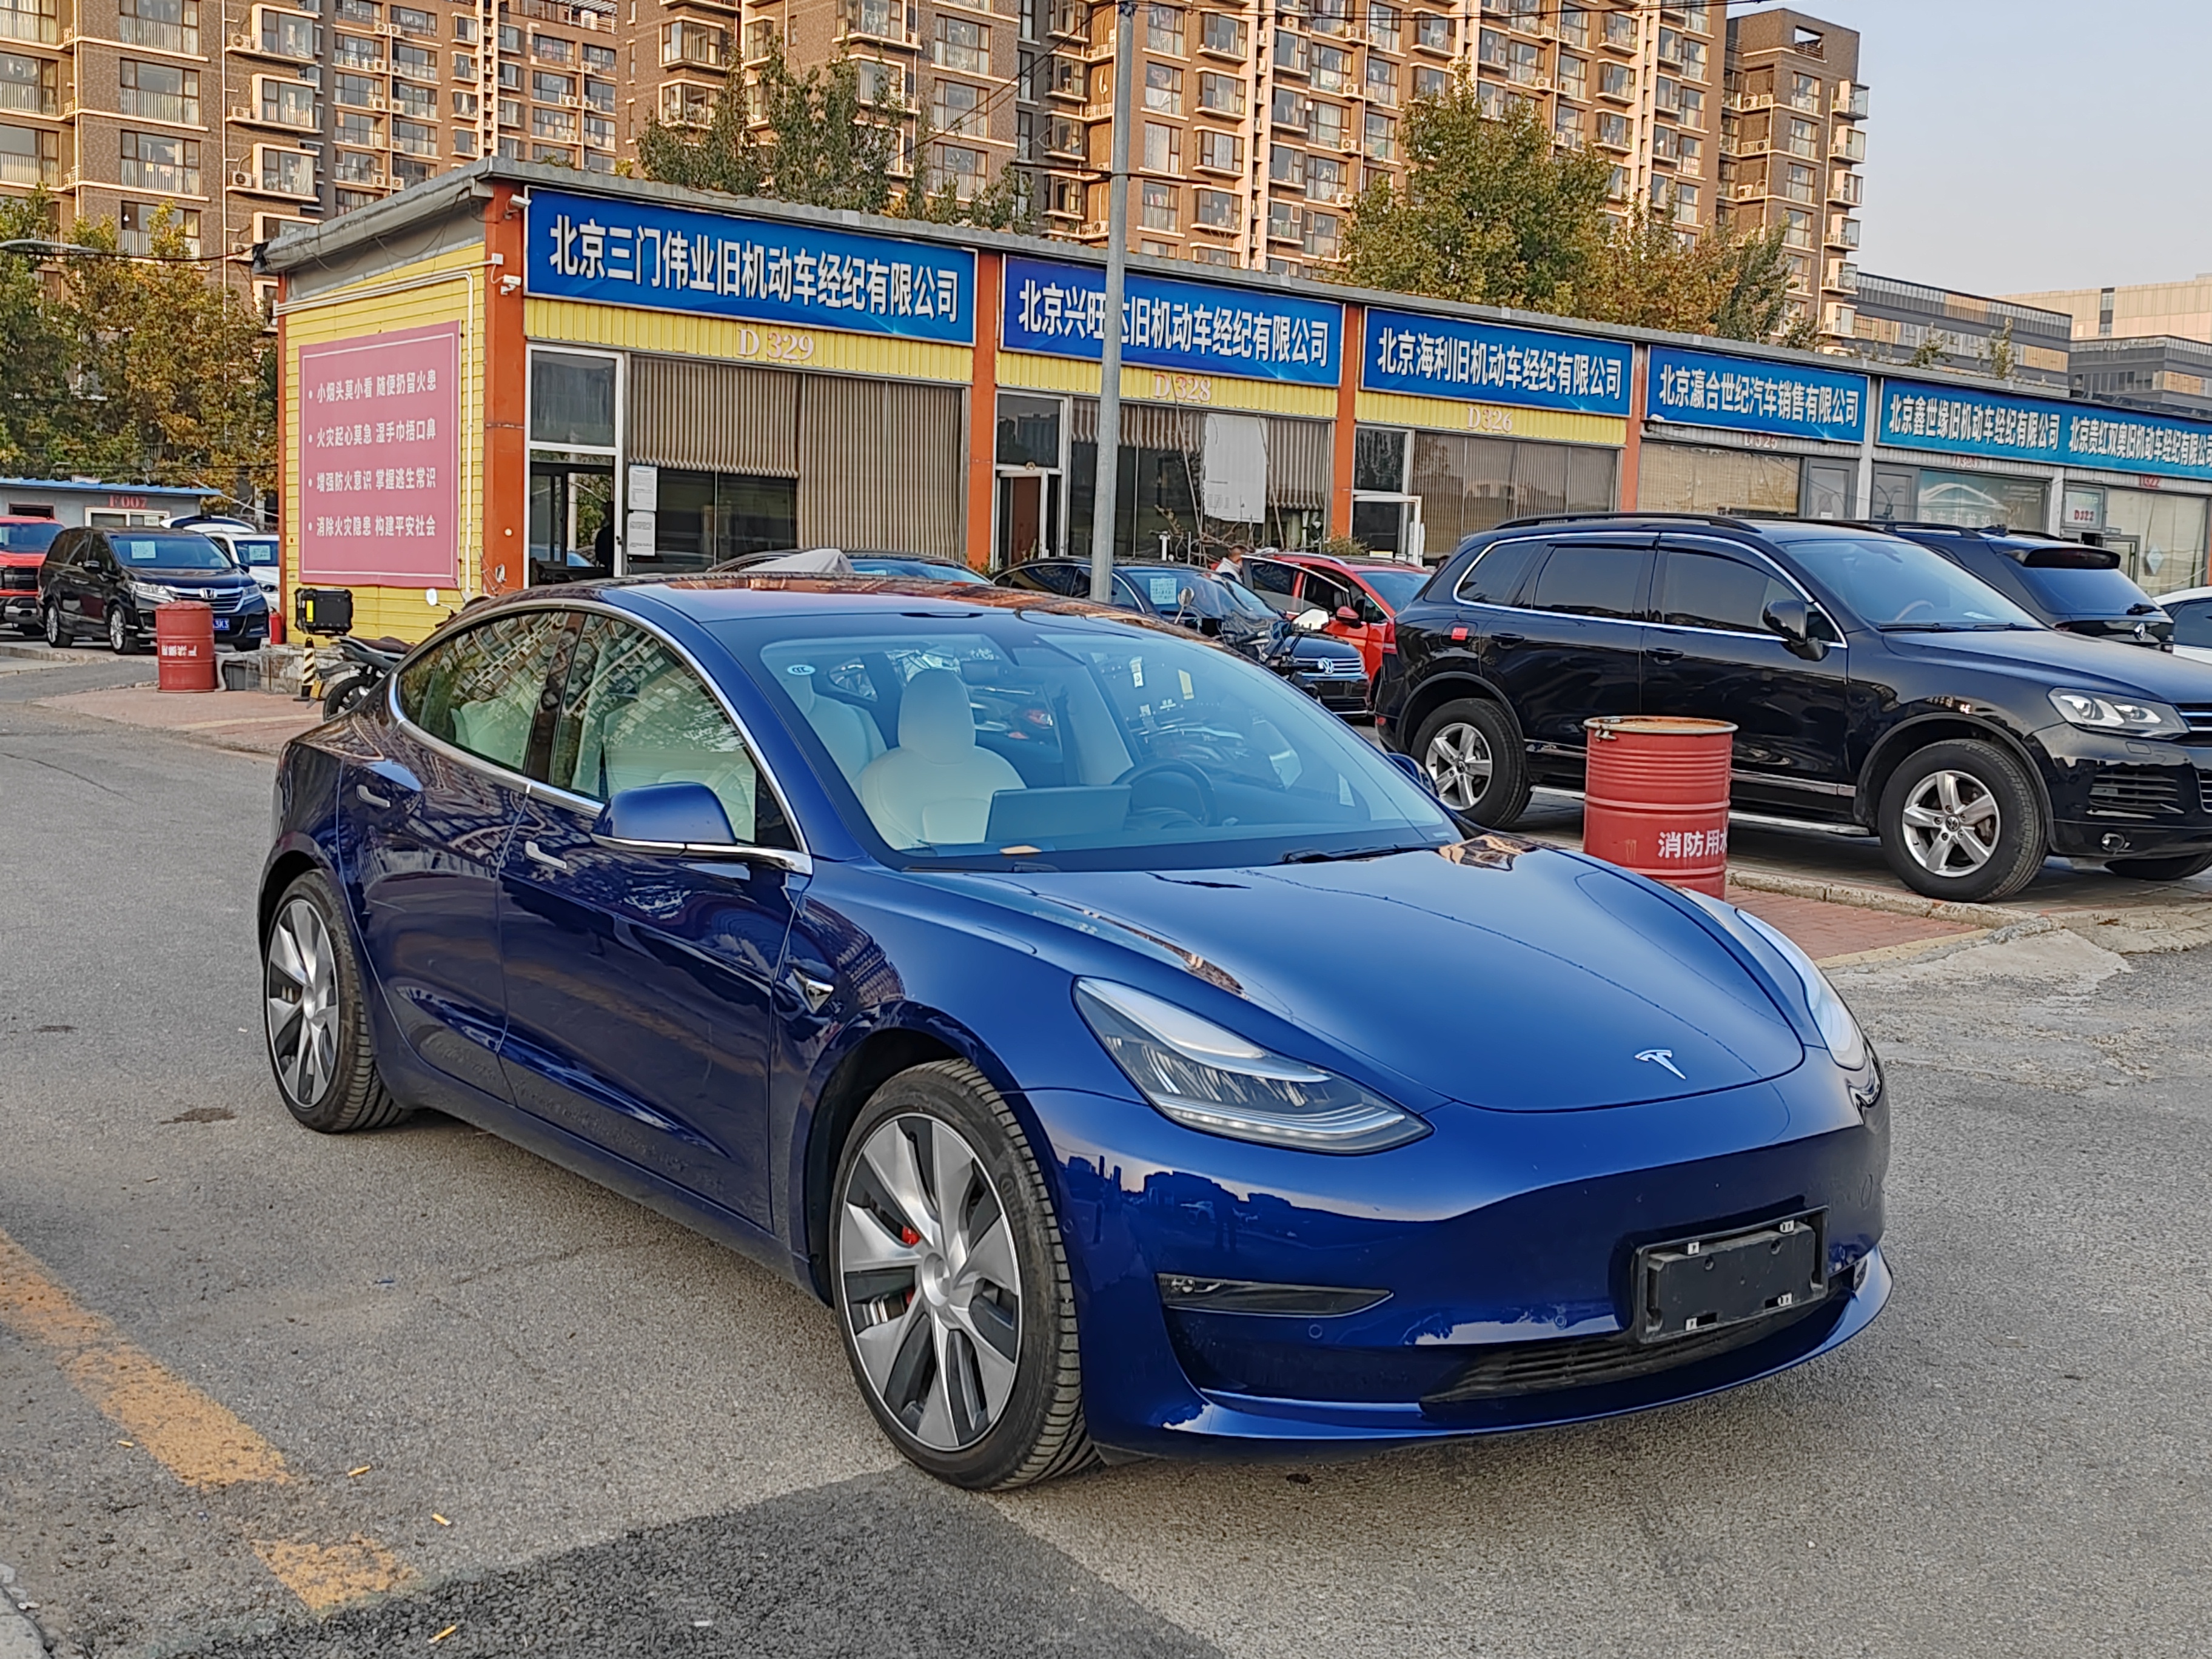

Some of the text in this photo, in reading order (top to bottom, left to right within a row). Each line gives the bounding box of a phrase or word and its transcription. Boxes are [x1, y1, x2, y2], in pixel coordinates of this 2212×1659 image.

[550, 215, 957, 322] 北京三门伟业旧机动车经纪有限公司
[1378, 327, 1621, 399] 北京海利旧机动车经纪有限公司
[317, 369, 437, 404] 小烟头莫小看 随便扔留火患
[1659, 364, 1858, 427] 北京瀛合世纪汽车销售有限公司
[317, 417, 436, 448] 火灾起心莫急 湿手巾捂口鼻
[1889, 394, 2060, 450] 北京鑫世缘旧机动车经纪有限公司
[317, 466, 436, 492] 增强防火意识 掌握逃生常识
[317, 514, 435, 537] 消除火灾隐患 构建平安社会
[1658, 827, 1728, 858] 消防用水
